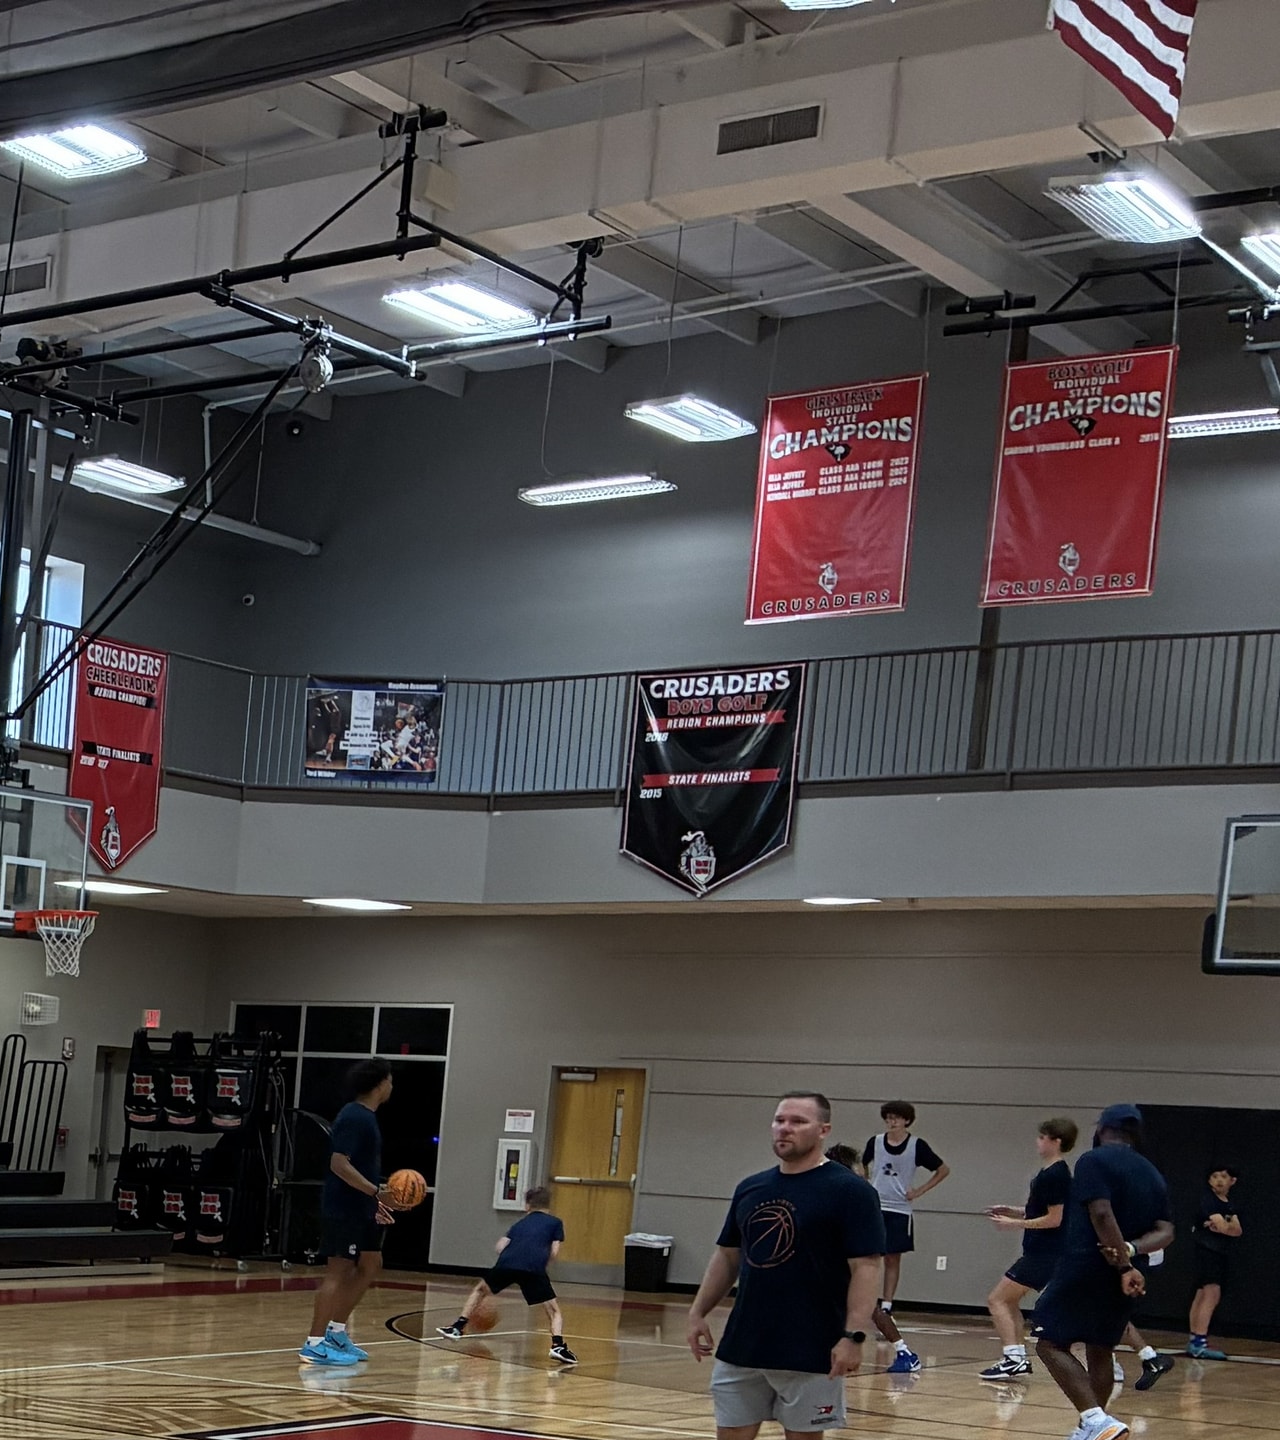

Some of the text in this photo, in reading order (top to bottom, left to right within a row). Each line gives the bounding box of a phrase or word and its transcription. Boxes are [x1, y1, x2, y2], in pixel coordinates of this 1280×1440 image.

[1053, 375, 1121, 389] INDIVIDUAL
[1069, 386, 1103, 398] STATE
[811, 402, 873, 419] INDIVIDUAL
[1009, 391, 1162, 432] CHAMPIONS
[826, 414, 857, 426] STATE
[769, 416, 913, 459] CHAMPIONS
[819, 465, 843, 476] CLASS
[819, 475, 841, 485] CLASS
[818, 484, 841, 495] CLASS
[998, 573, 1136, 596] CRUSADERS
[762, 589, 890, 614] CRUSADERS
[86, 643, 161, 677] CRUSADERS
[649, 670, 791, 698] CRUSADERS
[667, 693, 768, 715] BOYS GOLF
[667, 713, 767, 729] REGION CHAMPIONS
[668, 771, 751, 785] STATE FINALISTS
